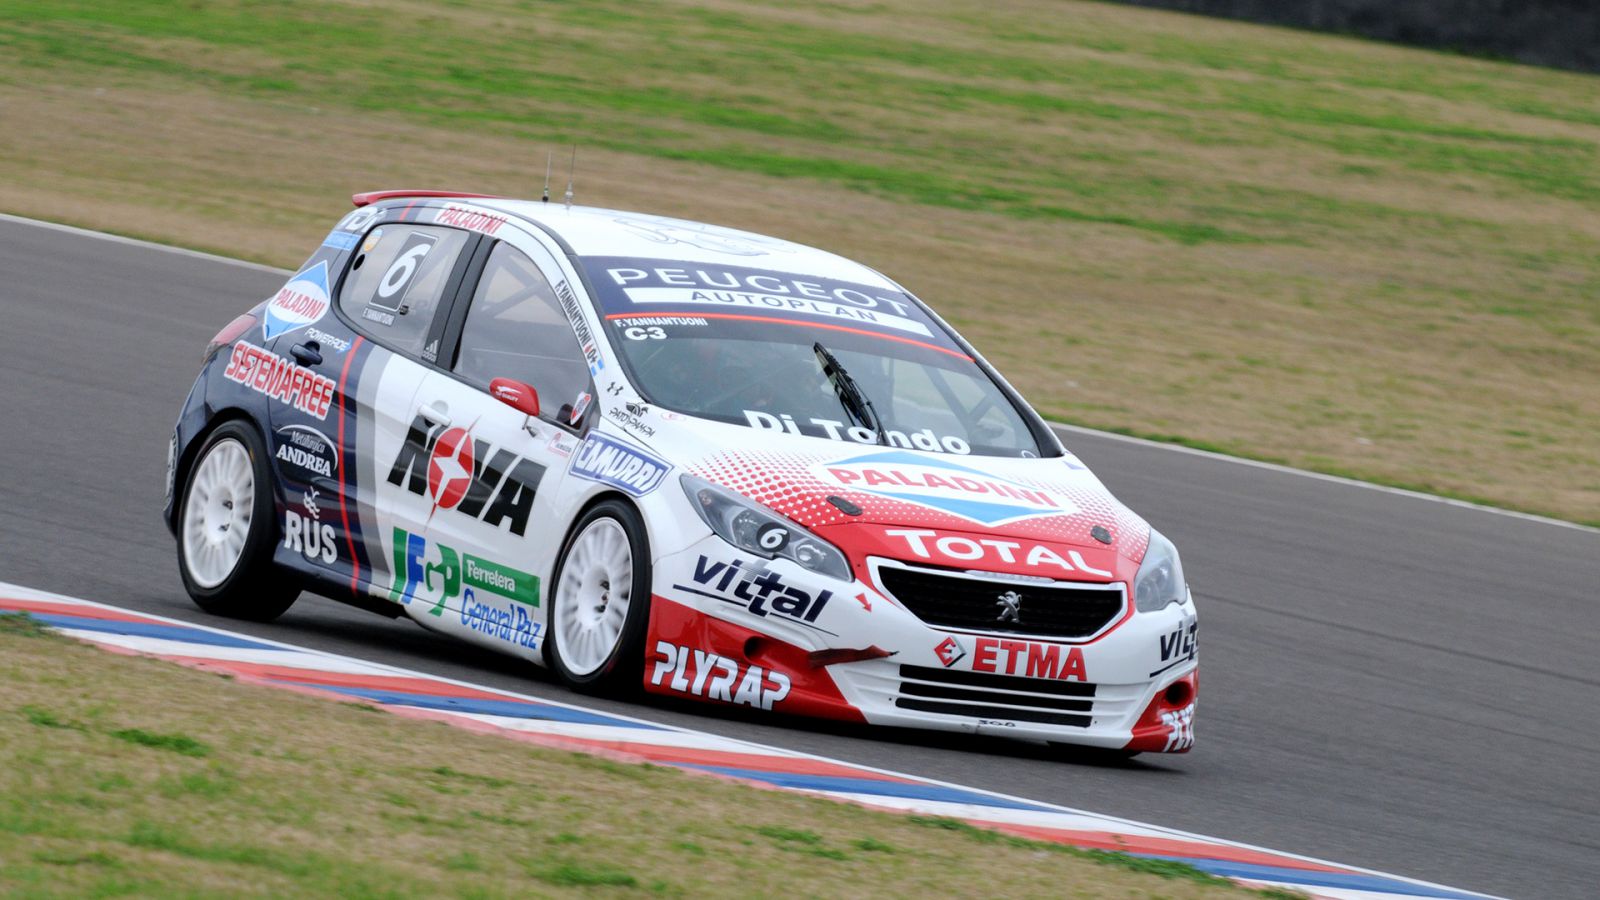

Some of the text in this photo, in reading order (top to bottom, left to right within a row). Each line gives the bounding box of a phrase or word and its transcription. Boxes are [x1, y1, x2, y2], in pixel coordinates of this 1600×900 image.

[436, 206, 507, 234] PALADINI
[378, 243, 431, 298] 6
[606, 268, 909, 316] PEUGEOT
[272, 286, 326, 320] PALADINI
[691, 290, 876, 322] AUTOPLAN
[625, 327, 667, 340] C3
[224, 340, 336, 420] SISTEMAFREE
[743, 409, 971, 455] Di Tondo
[276, 443, 332, 477] ANDREA
[387, 415, 548, 537] NOVA
[827, 467, 1059, 508] PALADINI
[284, 509, 338, 564] RUS
[760, 528, 788, 550] 6
[885, 530, 1113, 577] TOTAL
[466, 559, 516, 592] Ferretera
[461, 587, 542, 649] General Paz
[651, 640, 792, 711] PLYRAP
[972, 637, 1088, 682] ETMA
